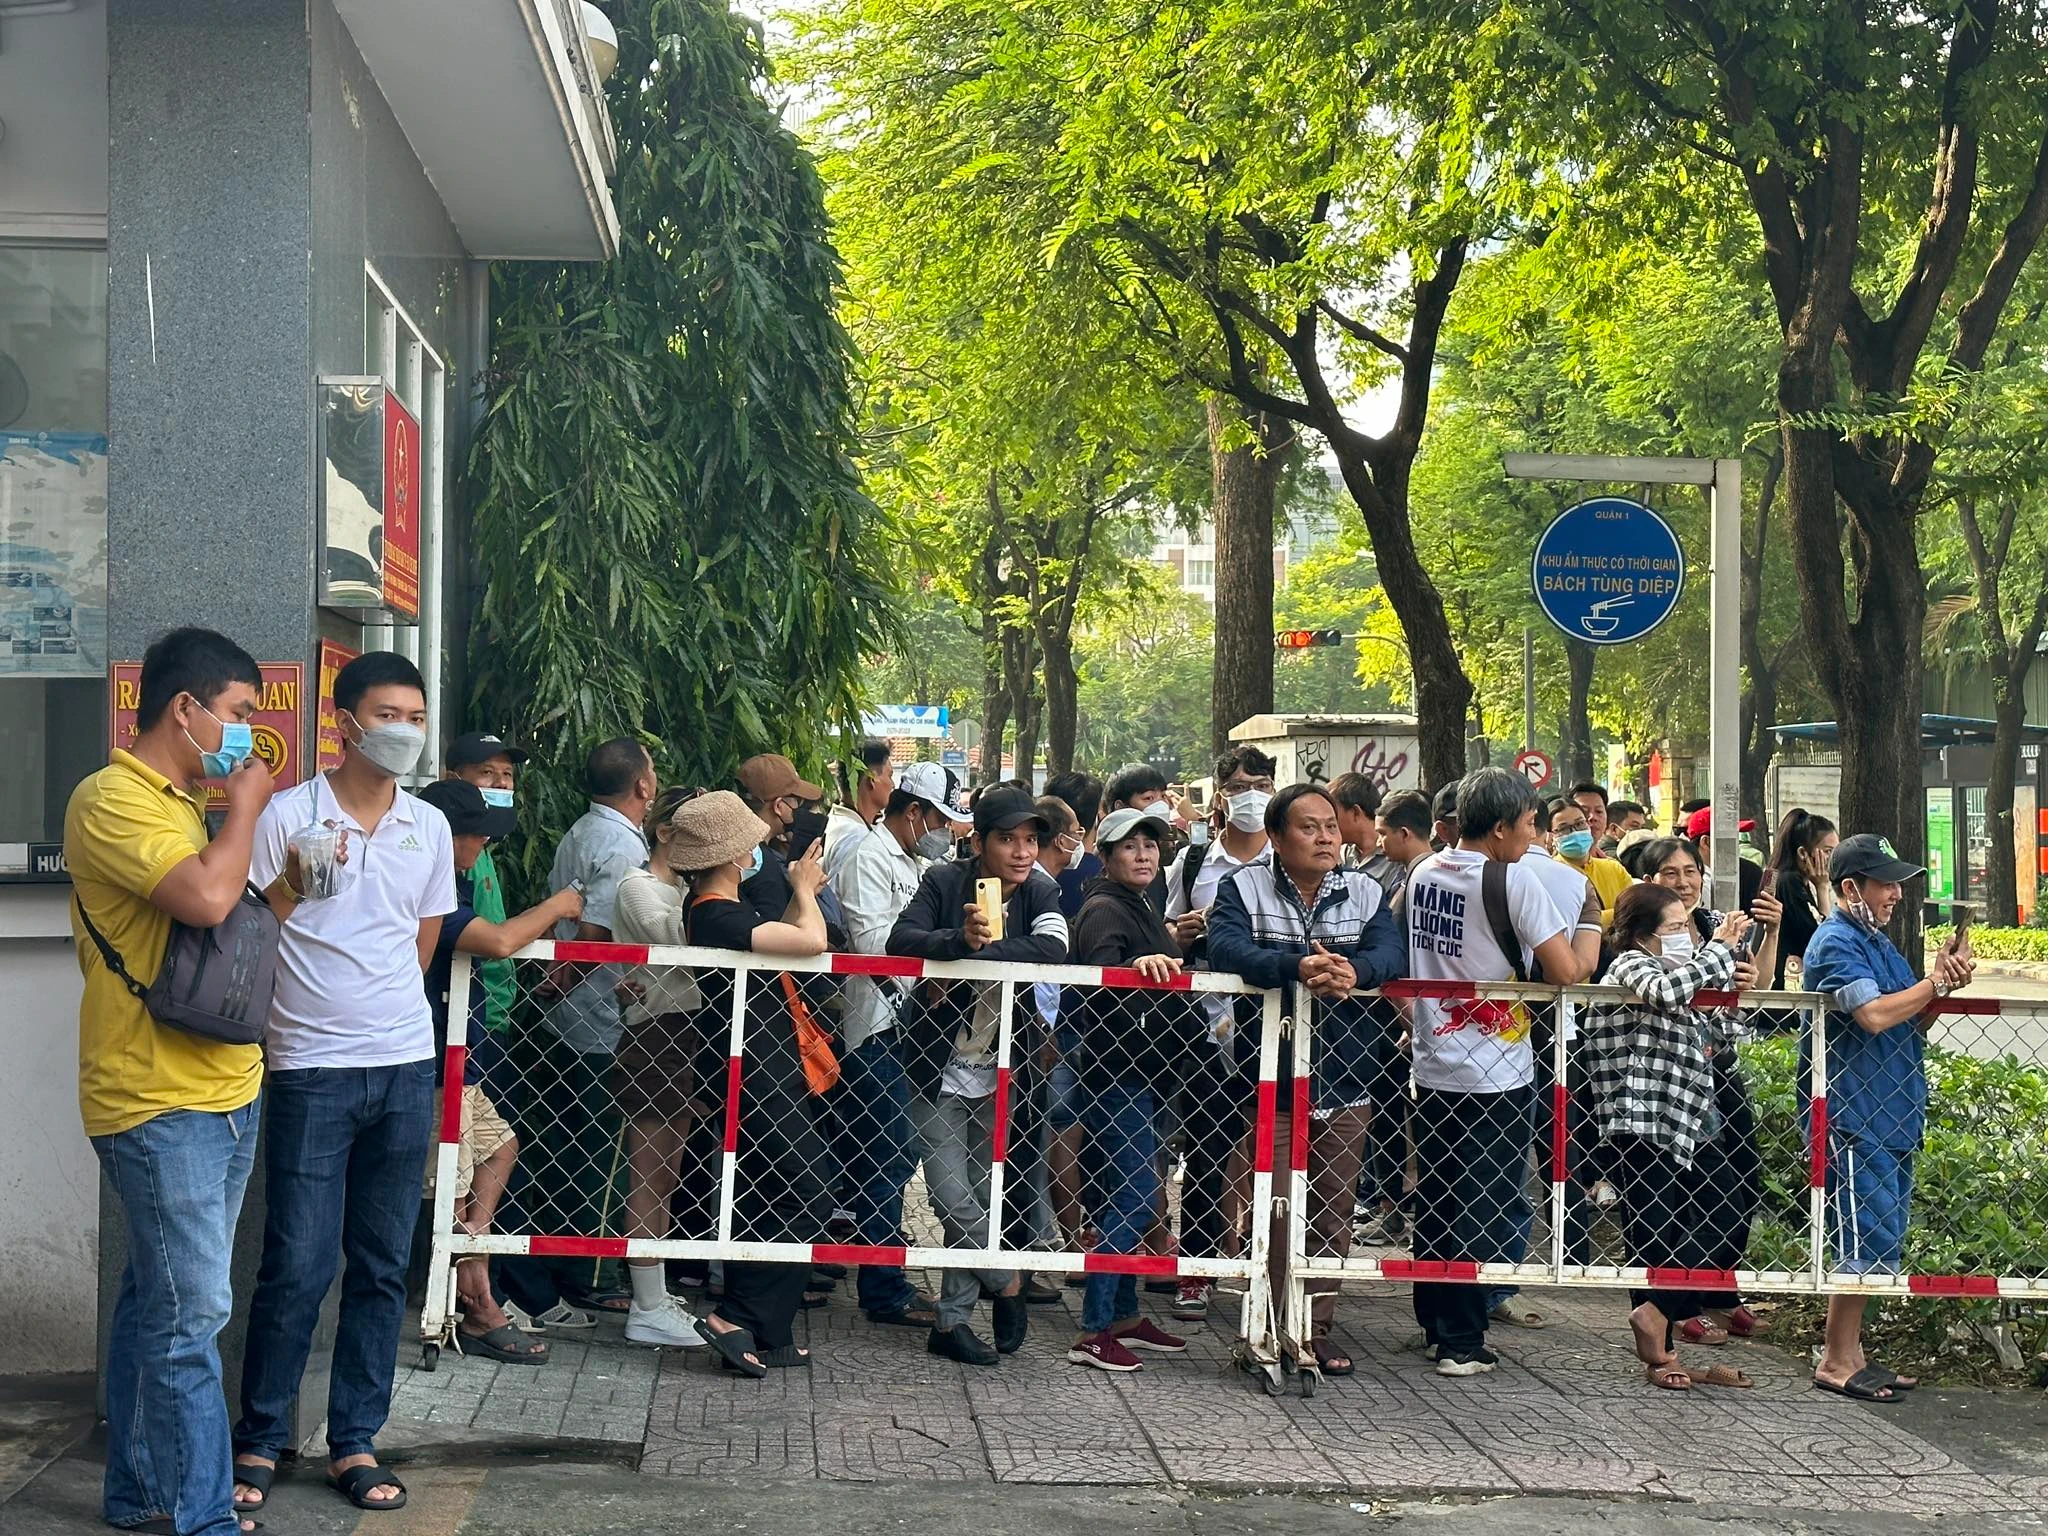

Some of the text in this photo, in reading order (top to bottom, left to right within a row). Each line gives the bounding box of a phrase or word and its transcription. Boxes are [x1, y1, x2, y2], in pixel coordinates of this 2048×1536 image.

[1625, 512, 1629, 520] 1
[1542, 554, 1562, 567] KHU
[1564, 550, 1579, 568] ẨM
[1610, 554, 1625, 569] CÓ
[1652, 559, 1676, 571] GIAN
[1543, 572, 1675, 598] BÁCH TÙNG DIỆP
[1413, 882, 1466, 918] NĂNG
[1412, 909, 1464, 940] LƯỢNG
[1411, 931, 1435, 952] TÍCH
